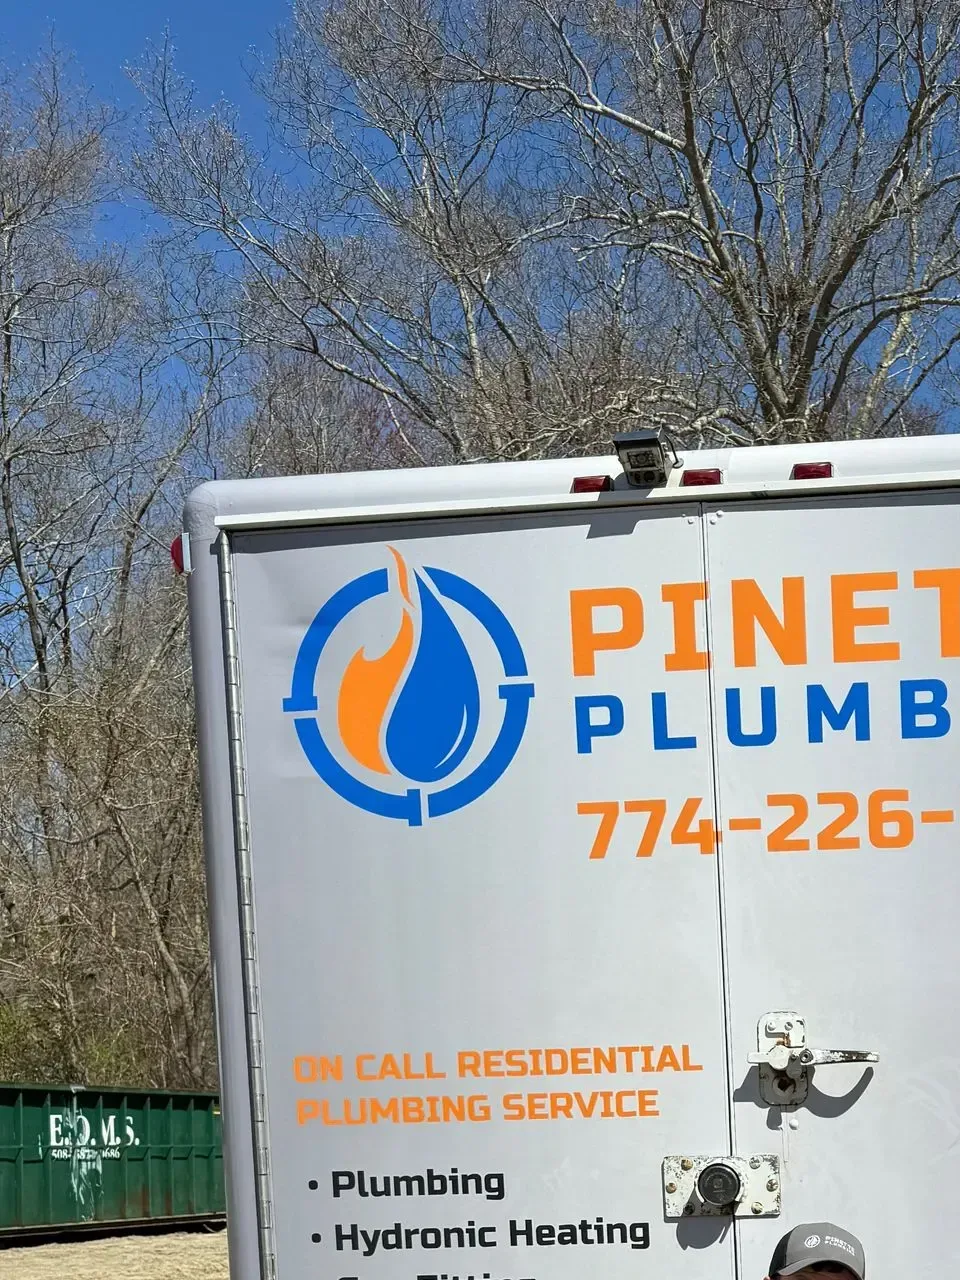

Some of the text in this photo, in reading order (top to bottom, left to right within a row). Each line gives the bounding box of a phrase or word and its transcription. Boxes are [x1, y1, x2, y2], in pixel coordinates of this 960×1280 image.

[293, 1045, 703, 1083] ON CALL RESIDENTIAL
[297, 1090, 659, 1126] PLUMBING SERVICE
[332, 1168, 504, 1200] Plumbing
[335, 1218, 649, 1256] Hydronic Heating
